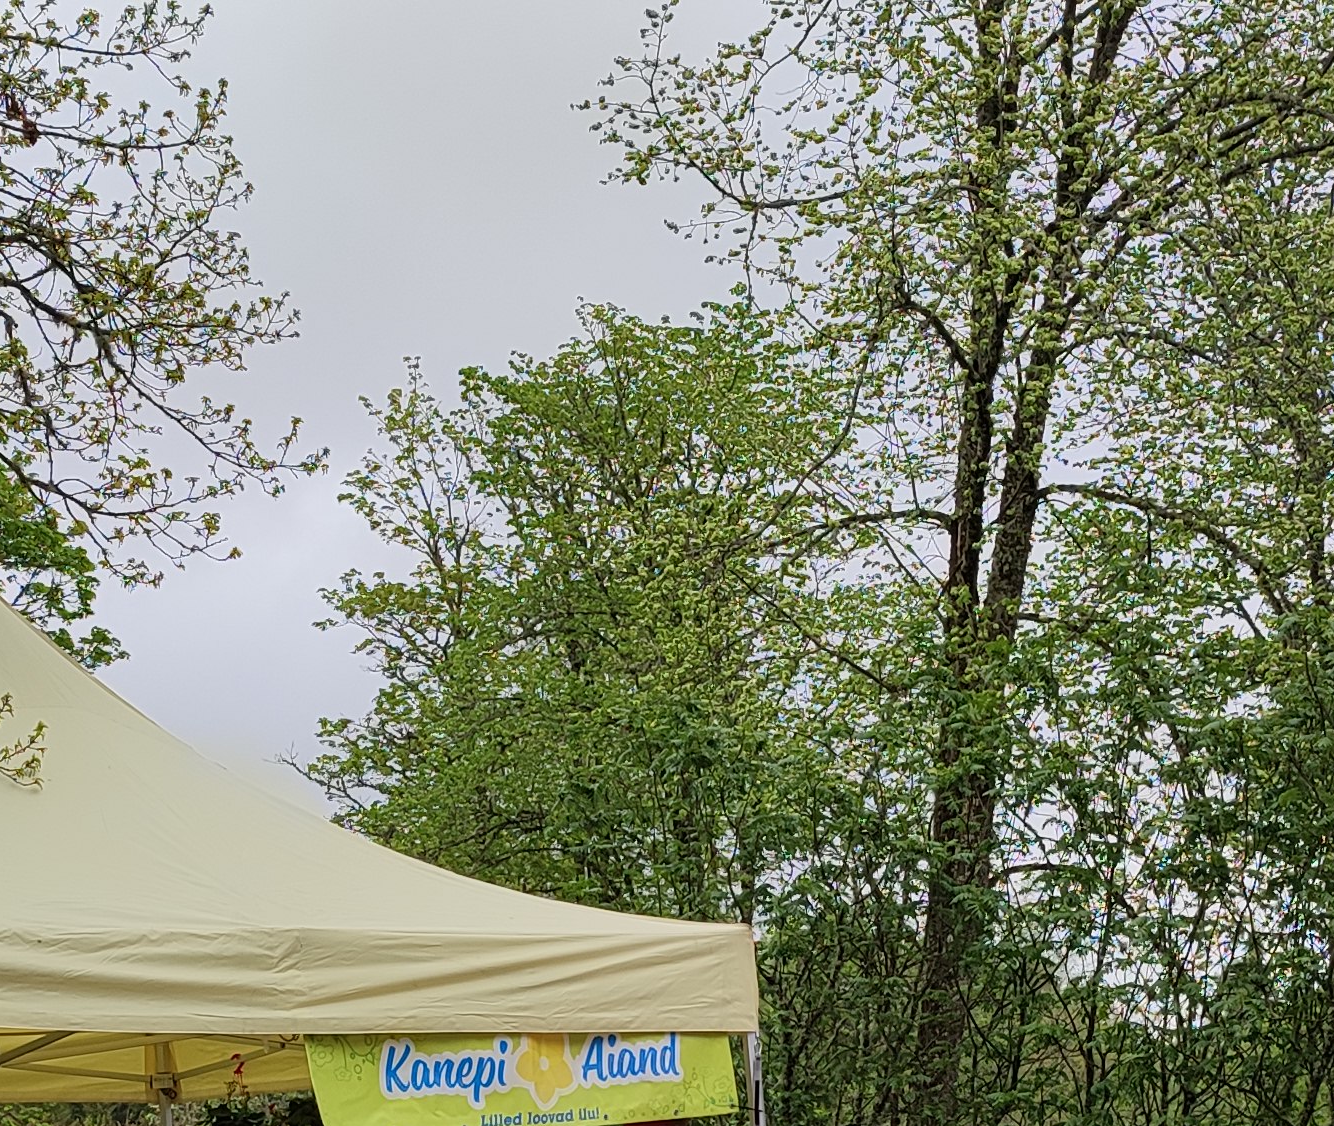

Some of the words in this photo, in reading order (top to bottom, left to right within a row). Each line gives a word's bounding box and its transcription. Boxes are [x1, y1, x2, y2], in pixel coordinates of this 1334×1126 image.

[385, 1040, 508, 1103] Kanepi
[582, 1032, 680, 1082] Aiand
[527, 1109, 574, 1126] loovad
